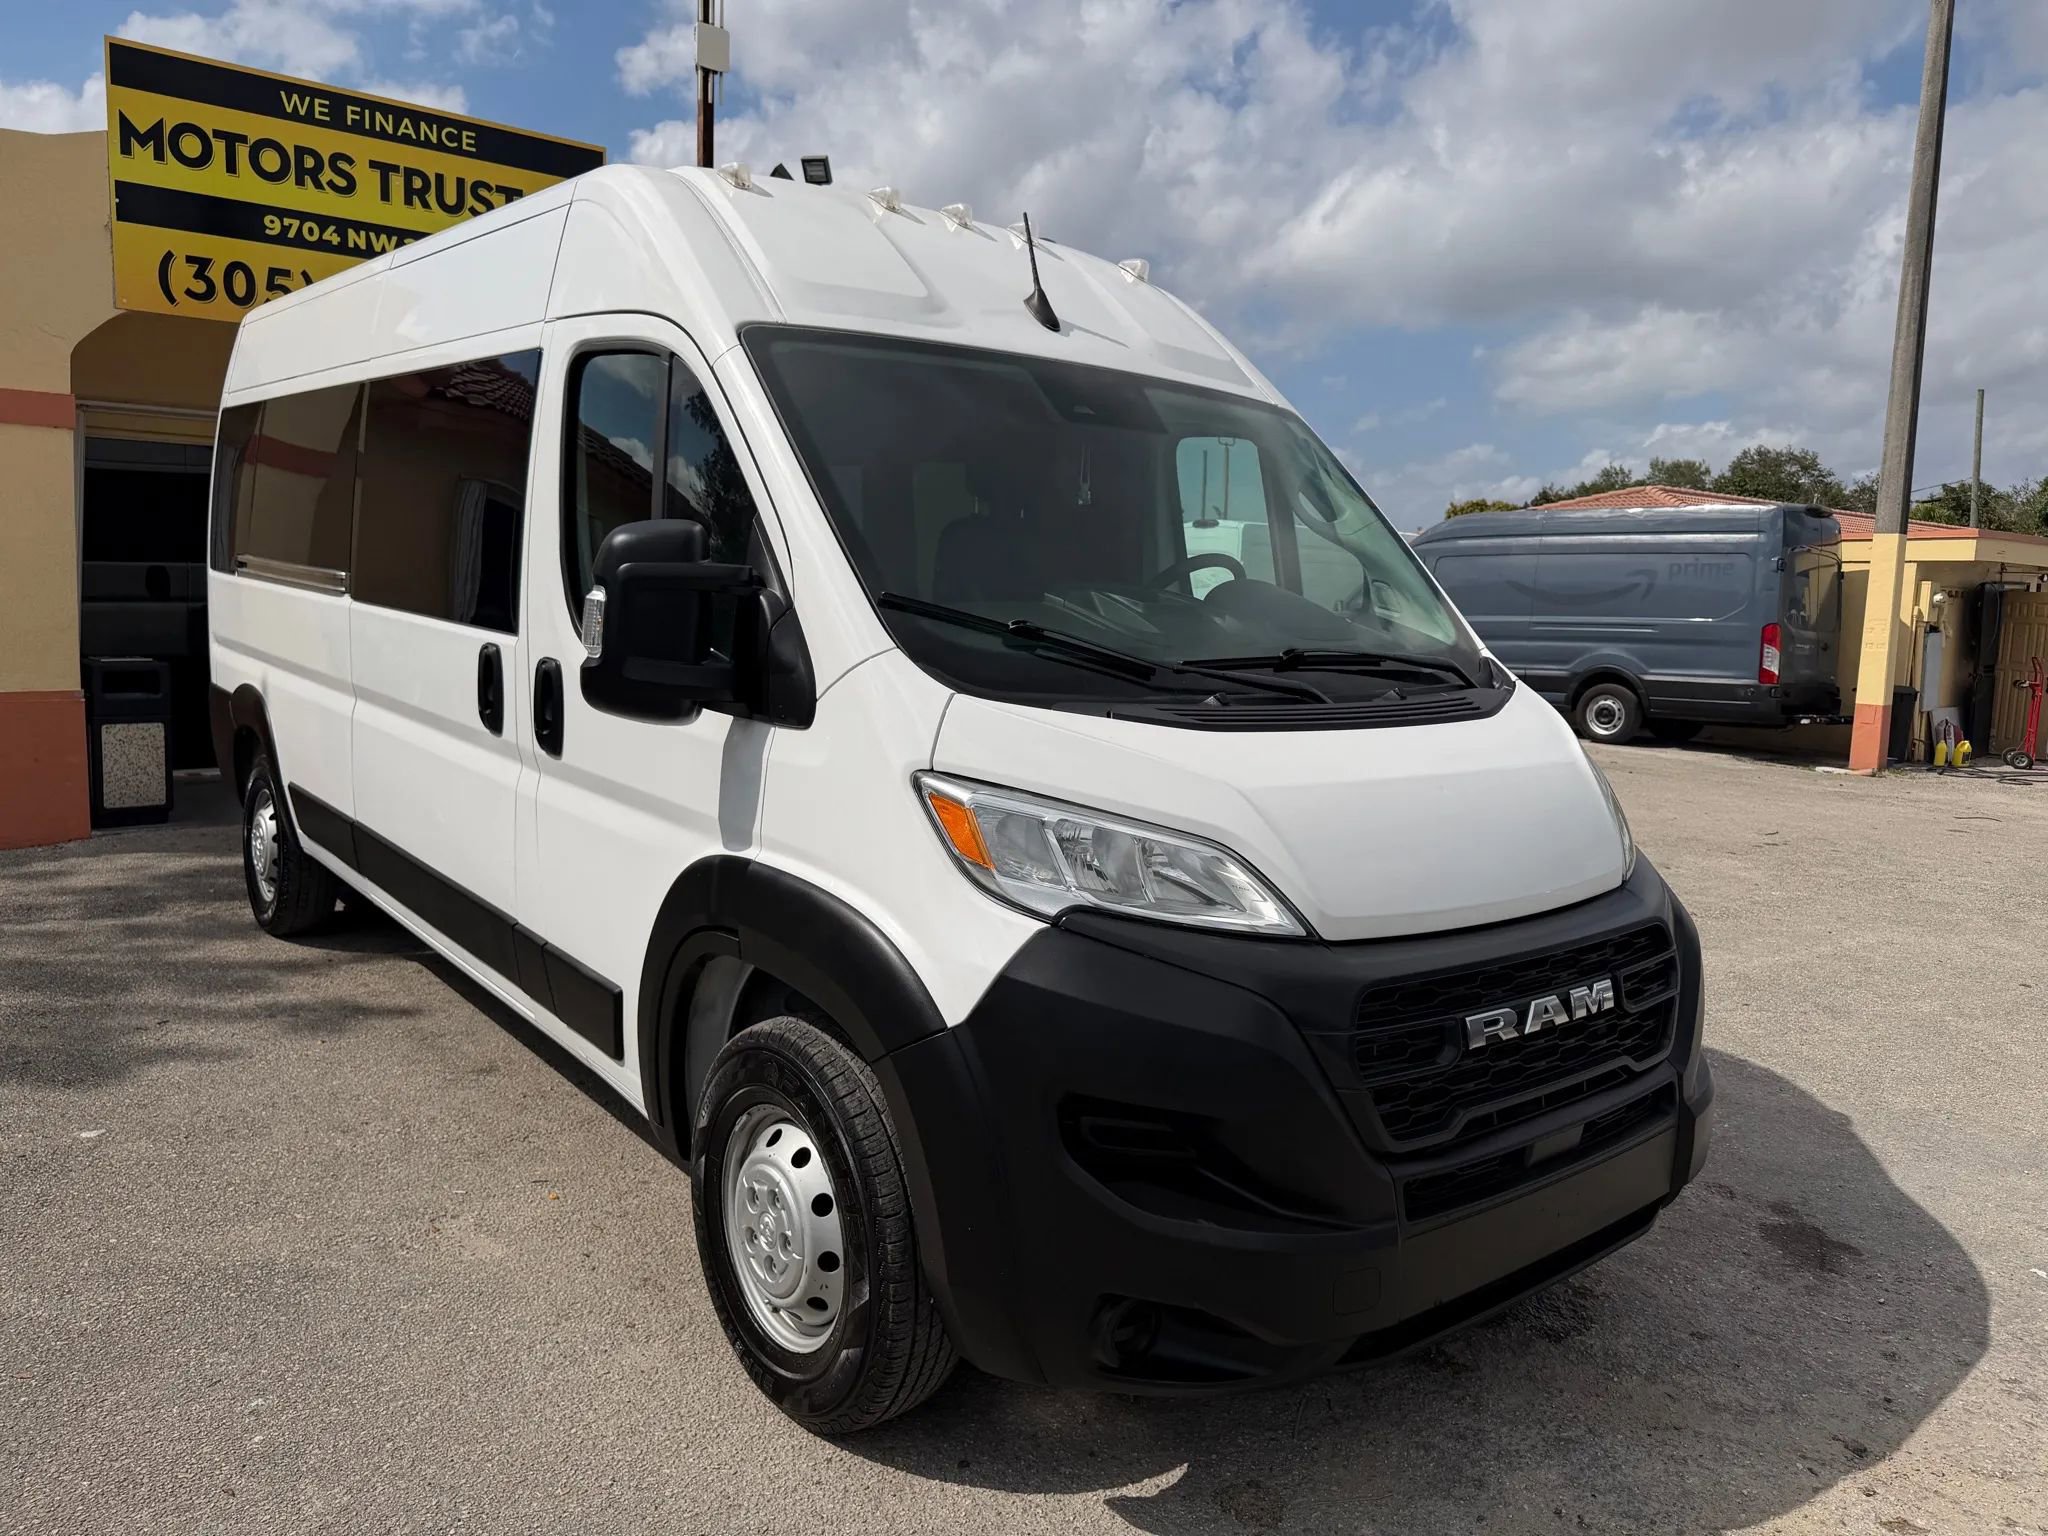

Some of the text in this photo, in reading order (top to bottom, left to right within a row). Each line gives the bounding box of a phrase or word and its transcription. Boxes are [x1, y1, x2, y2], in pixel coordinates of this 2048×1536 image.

[280, 90, 477, 152] WE FINANCE
[118, 108, 358, 198] MOTORS
[263, 214, 398, 253] 9704 NW
[1667, 557, 1735, 581] prime
[1465, 979, 1615, 1050] RAM
